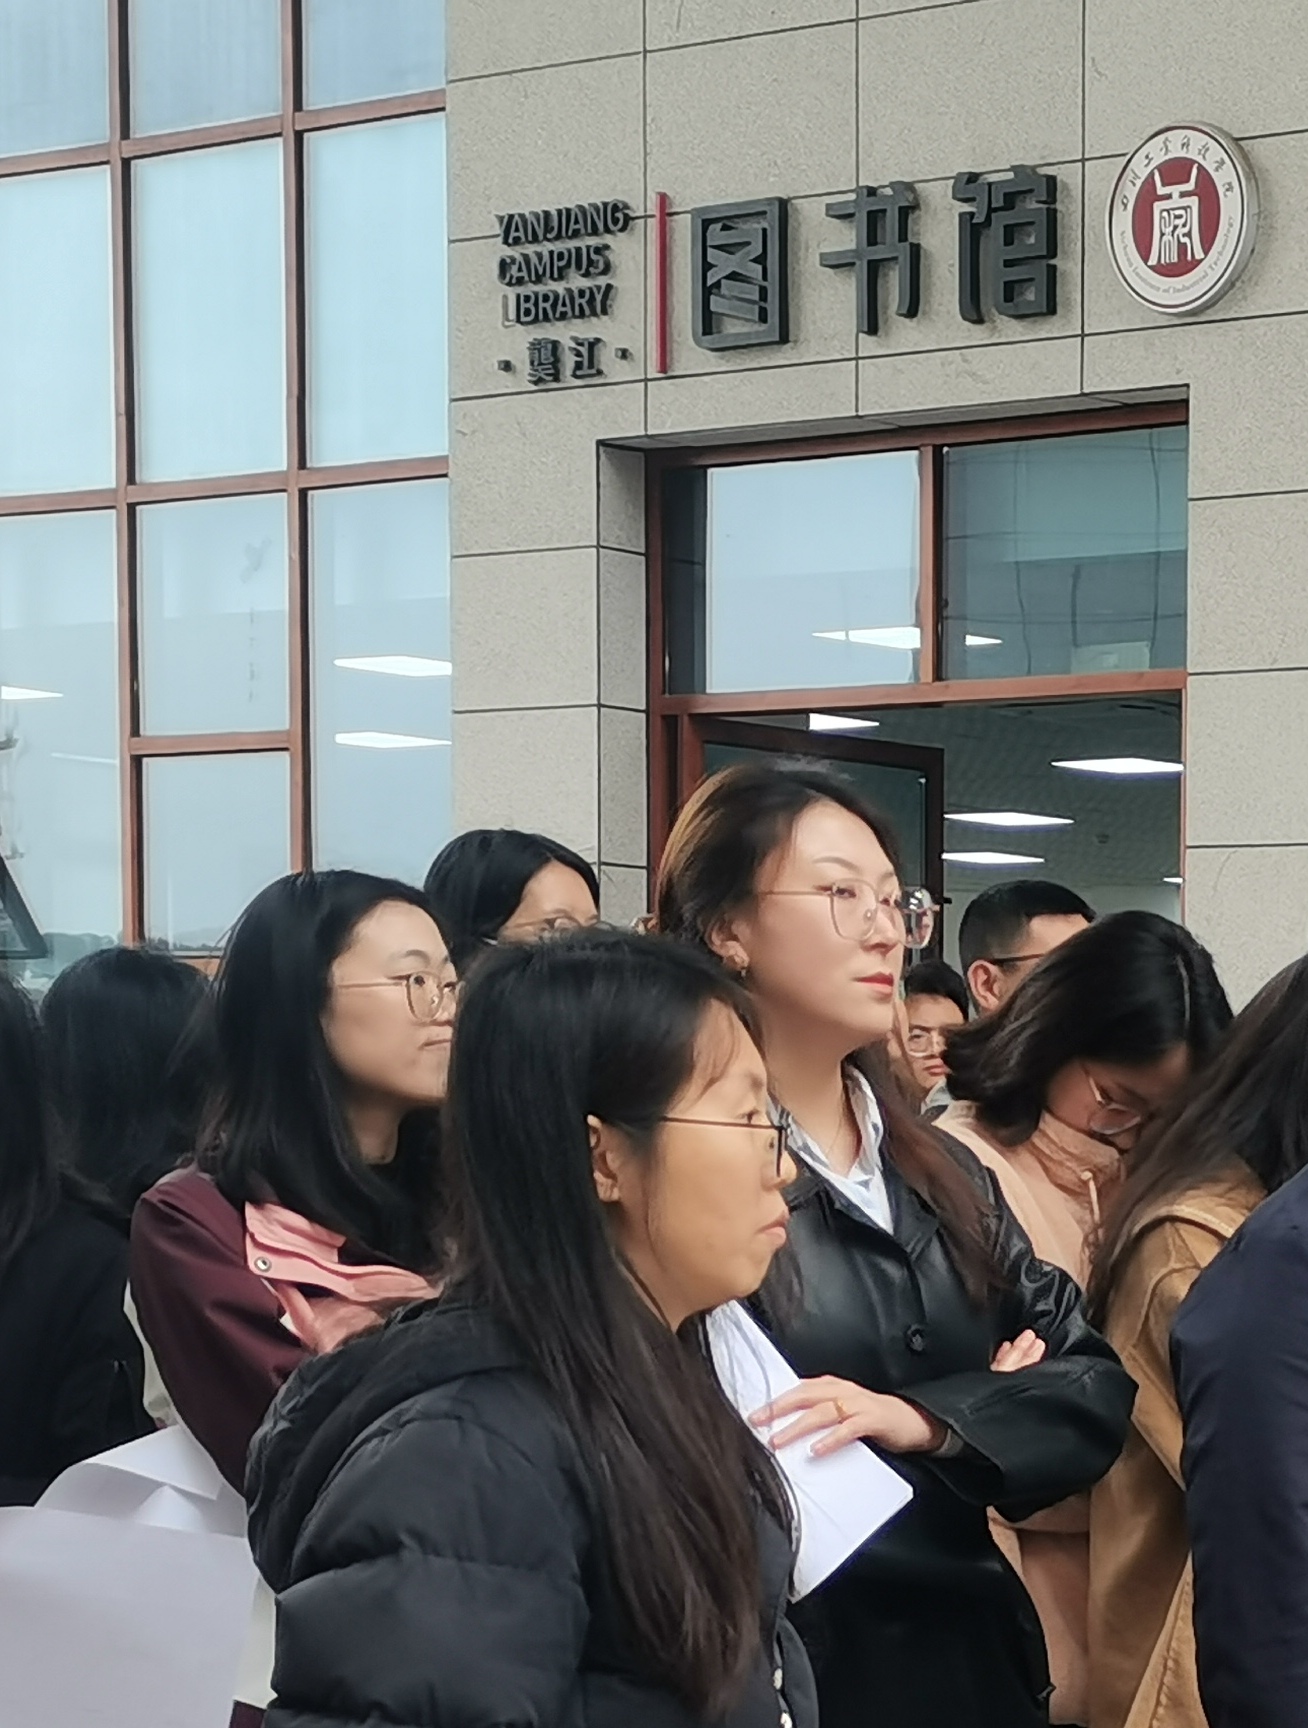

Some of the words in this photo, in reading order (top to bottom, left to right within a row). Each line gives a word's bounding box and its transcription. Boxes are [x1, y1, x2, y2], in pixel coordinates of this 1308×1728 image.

[495, 200, 632, 245] YANJIANG
[498, 243, 612, 286] CAMPUS
[691, 164, 1057, 352] 图书馆
[502, 283, 615, 328] LIBRARY
